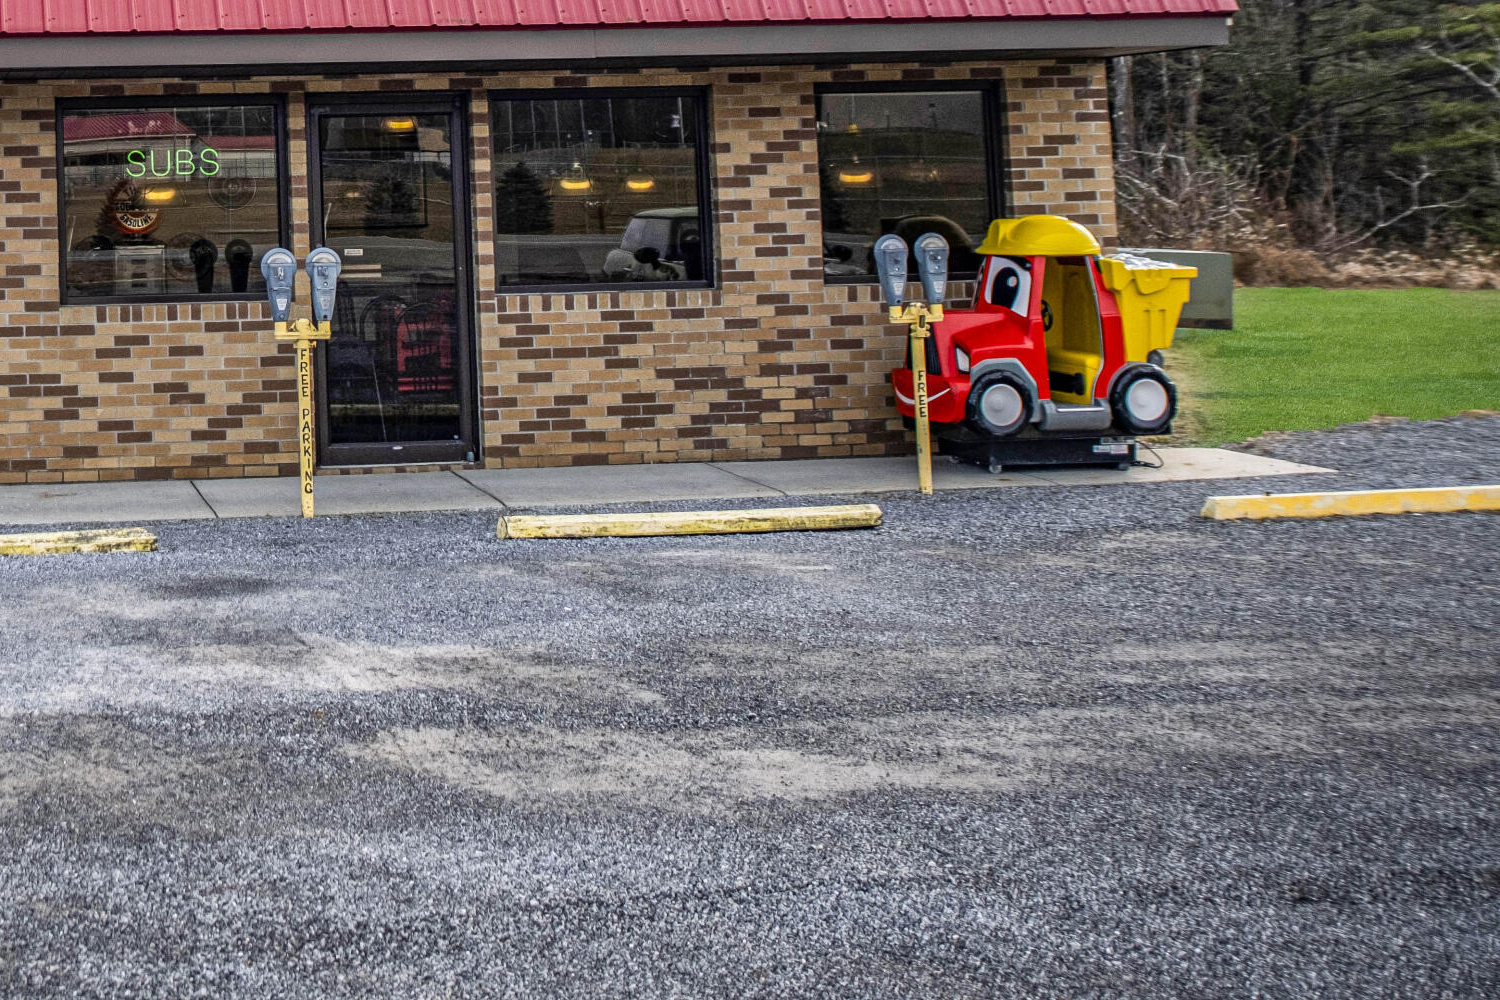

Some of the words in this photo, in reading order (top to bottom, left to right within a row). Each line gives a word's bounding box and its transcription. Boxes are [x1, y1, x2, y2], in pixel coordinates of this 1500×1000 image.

[126, 148, 220, 177] SUBS
[120, 212, 154, 228] GASOLINE
[299, 349, 309, 397] FREE
[917, 370, 927, 418] FREE
[302, 408, 313, 494] PARKING
